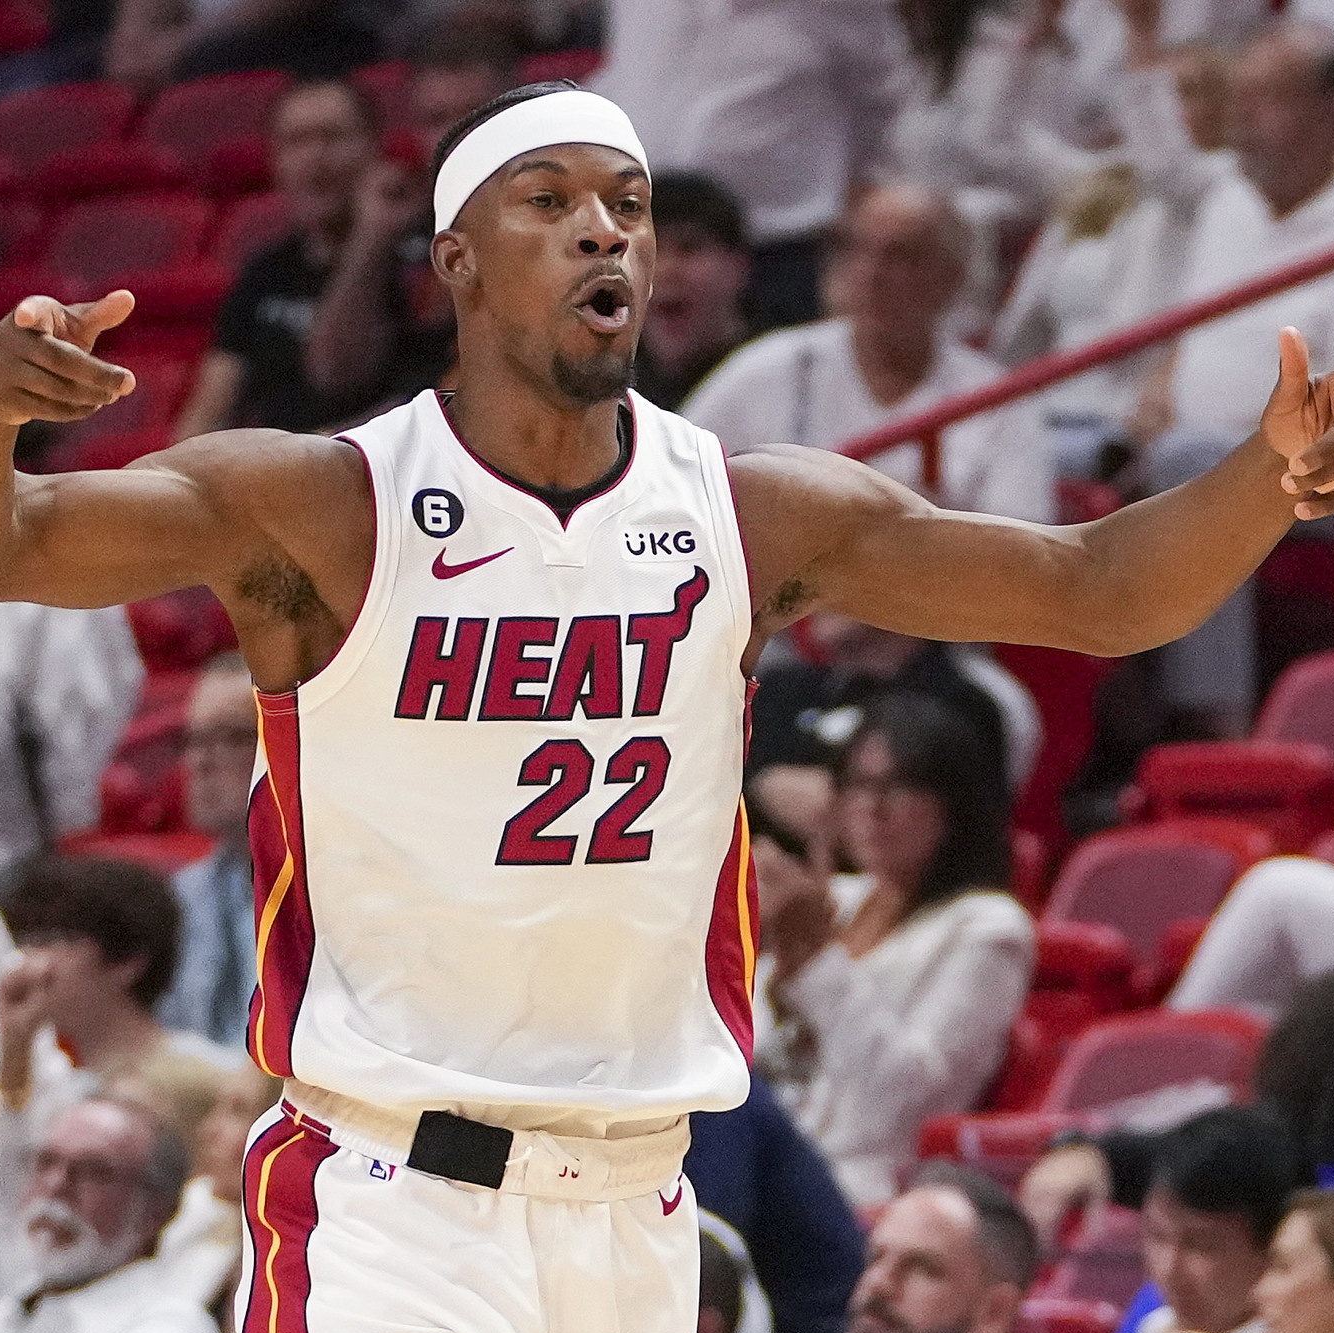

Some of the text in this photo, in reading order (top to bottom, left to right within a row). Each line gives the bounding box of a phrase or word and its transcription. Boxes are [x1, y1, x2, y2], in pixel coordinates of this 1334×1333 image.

[422, 494, 451, 533] 6
[393, 564, 710, 722] HEAT
[494, 735, 672, 866] 22
